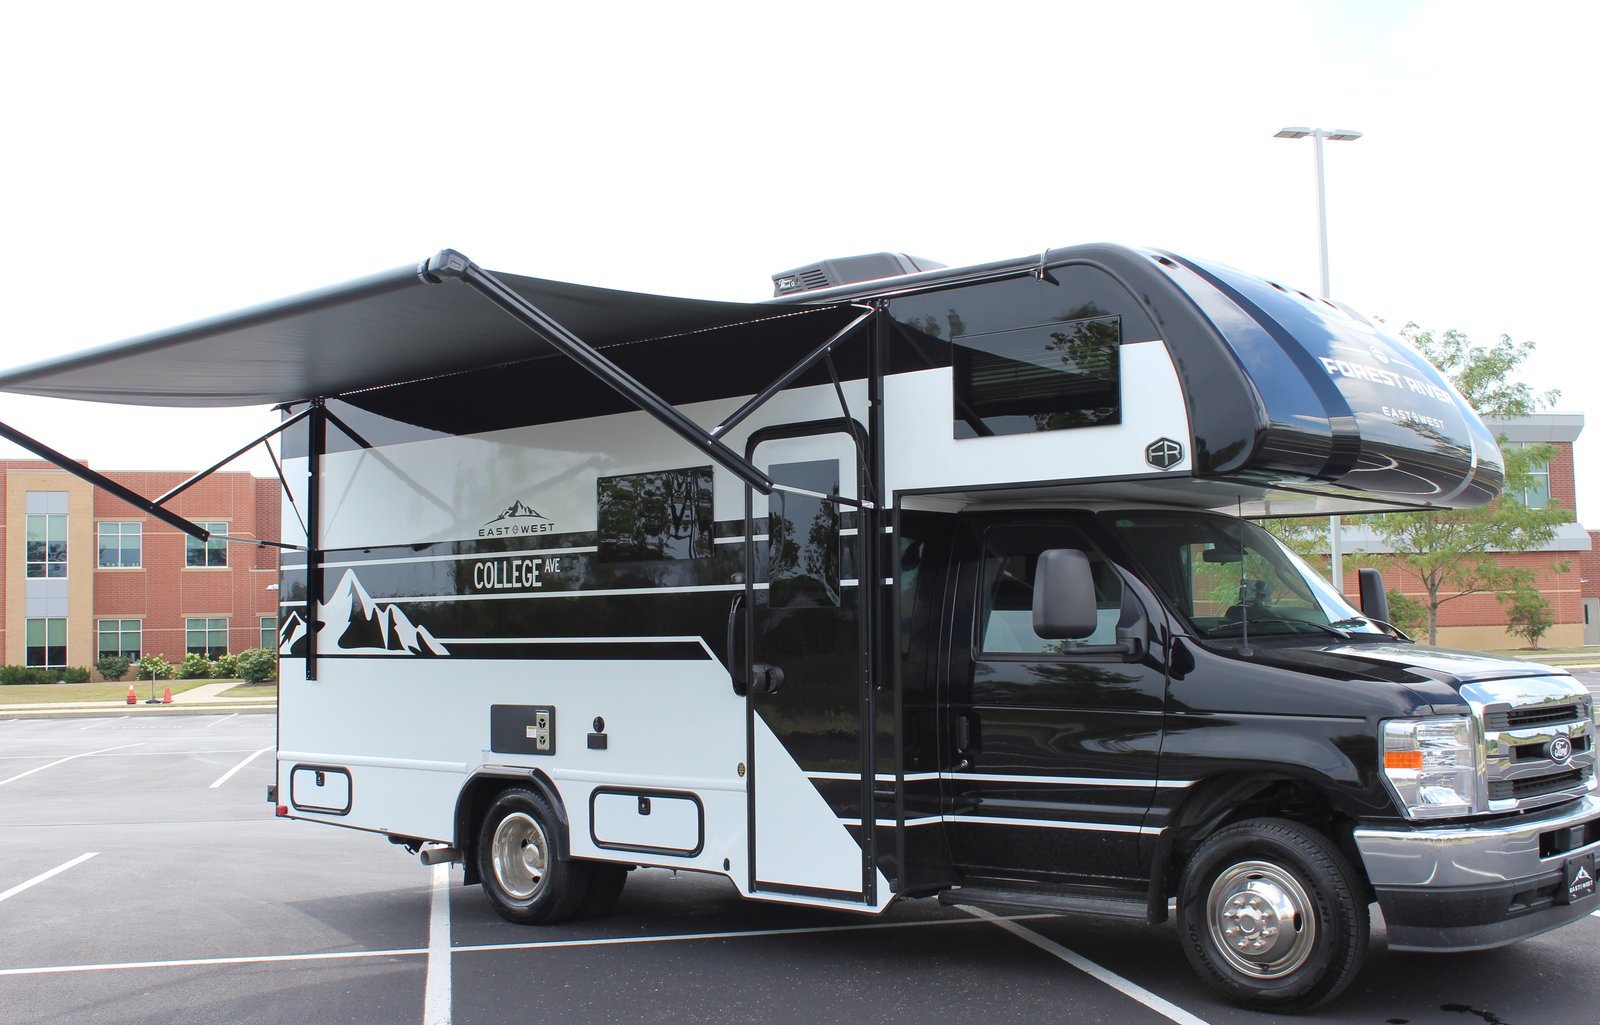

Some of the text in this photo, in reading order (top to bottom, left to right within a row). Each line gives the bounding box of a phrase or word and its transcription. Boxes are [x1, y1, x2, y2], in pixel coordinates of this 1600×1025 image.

[1317, 356, 1457, 407] FOREST RIVER
[1381, 406, 1445, 430] EAST WEST
[478, 523, 555, 537] EAST WEST
[474, 558, 561, 589] COLLEGE AVE
